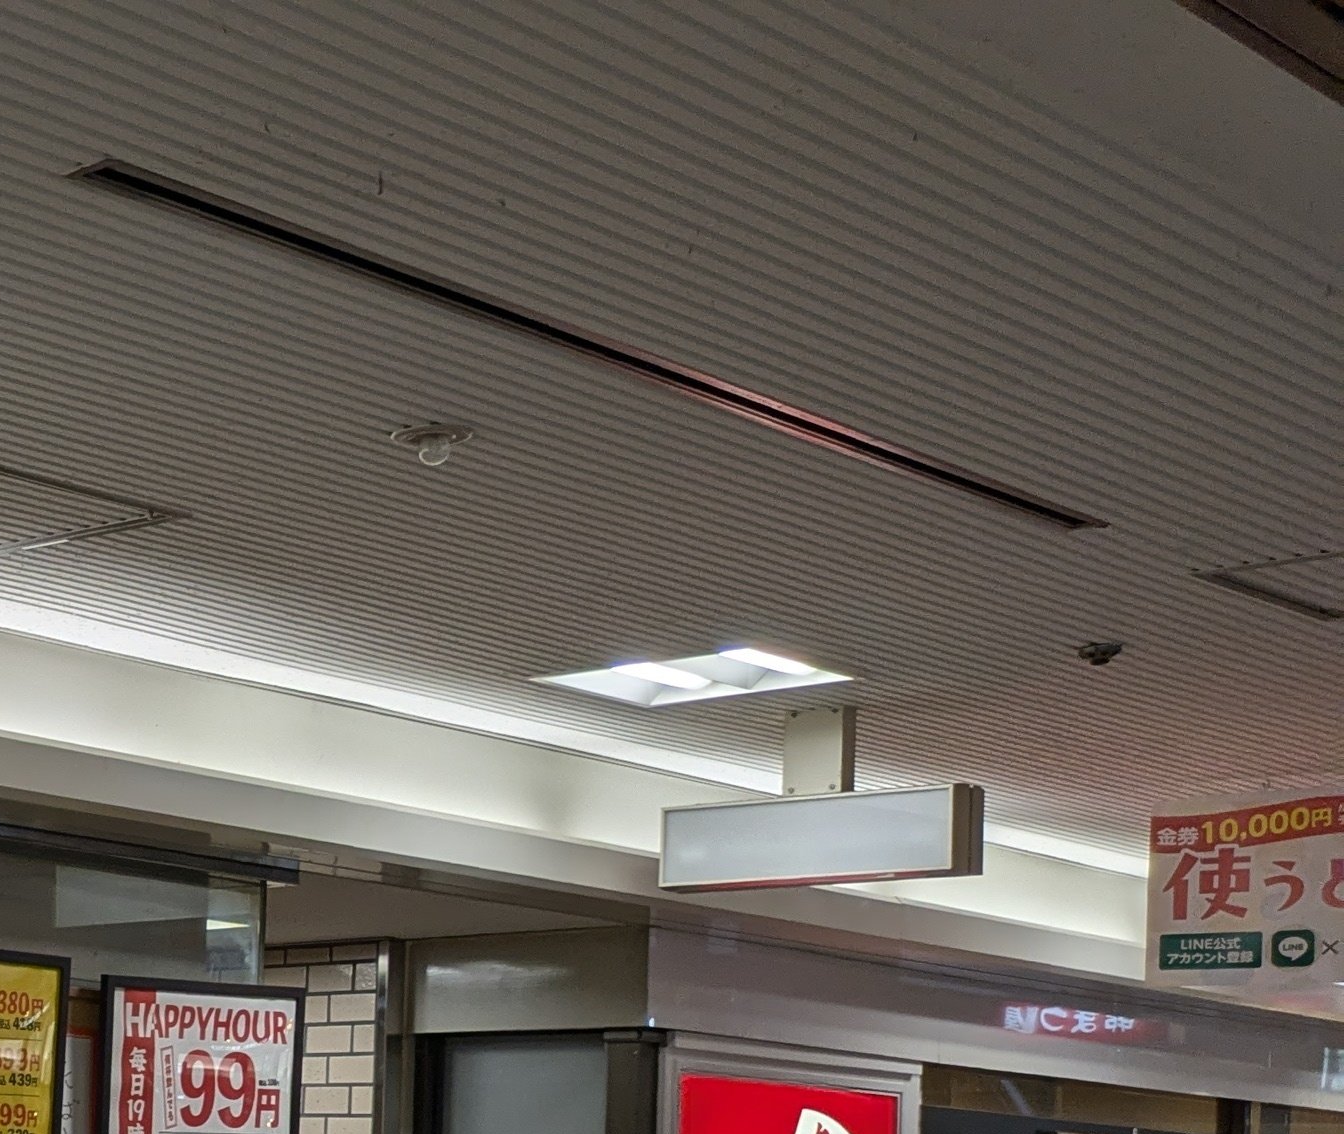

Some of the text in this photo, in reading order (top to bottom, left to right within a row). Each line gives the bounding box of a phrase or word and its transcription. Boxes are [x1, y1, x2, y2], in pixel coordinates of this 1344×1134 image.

[1155, 806, 1333, 846] 金券 10,000円
[1179, 937, 1241, 952] LINE公式
[1282, 942, 1304, 953] LINE
[1166, 951, 1254, 966] アカウント登録
[125, 1002, 288, 1045] HAPPYHOUR
[180, 1049, 281, 1129] 99円
